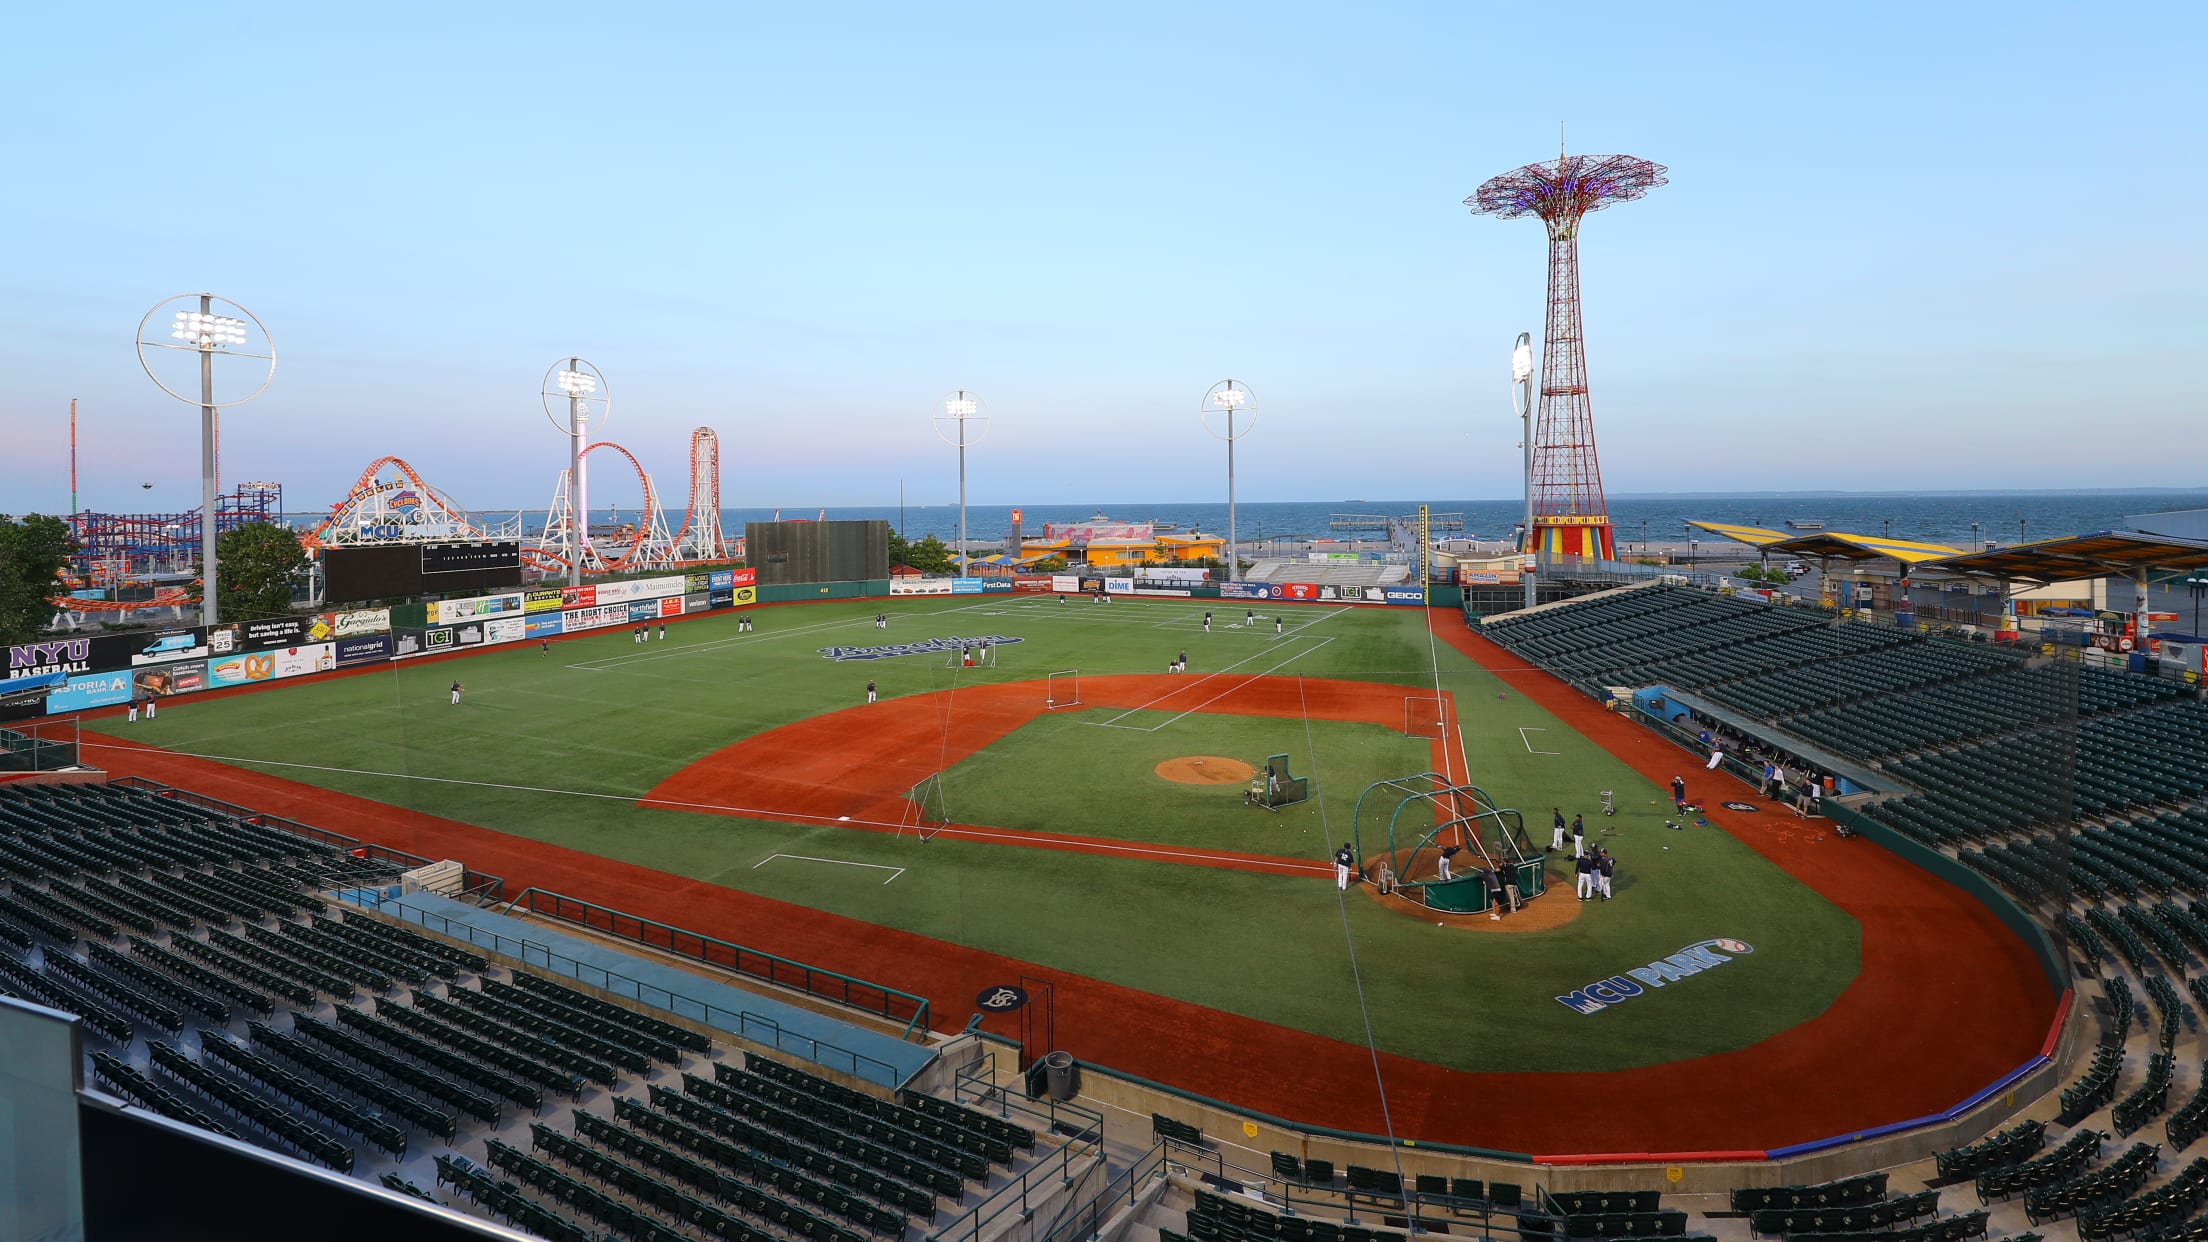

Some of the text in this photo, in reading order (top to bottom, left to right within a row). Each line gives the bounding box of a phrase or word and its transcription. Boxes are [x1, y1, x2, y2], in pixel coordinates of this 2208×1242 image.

[360, 525, 399, 539] MCU
[645, 580, 684, 591] Maimonides
[983, 581, 997, 589] First
[997, 580, 1011, 589] Data
[1108, 579, 1130, 591] DIME
[1386, 591, 1423, 600] GEICO
[564, 604, 628, 620] THE RIGHT CHOICE
[629, 601, 657, 613] Northfield
[250, 623, 271, 632] Driving
[284, 621, 299, 630] easy.
[336, 614, 388, 630] Gargiulo's
[216, 640, 231, 650] 25
[343, 640, 384, 654] nationalgrid
[10, 638, 90, 669] NYU
[9, 661, 91, 679] BASEBALL
[53, 679, 107, 695] ASTORIA
[86, 687, 107, 695] BANK
[1553, 945, 1734, 1016] MCU PARK
